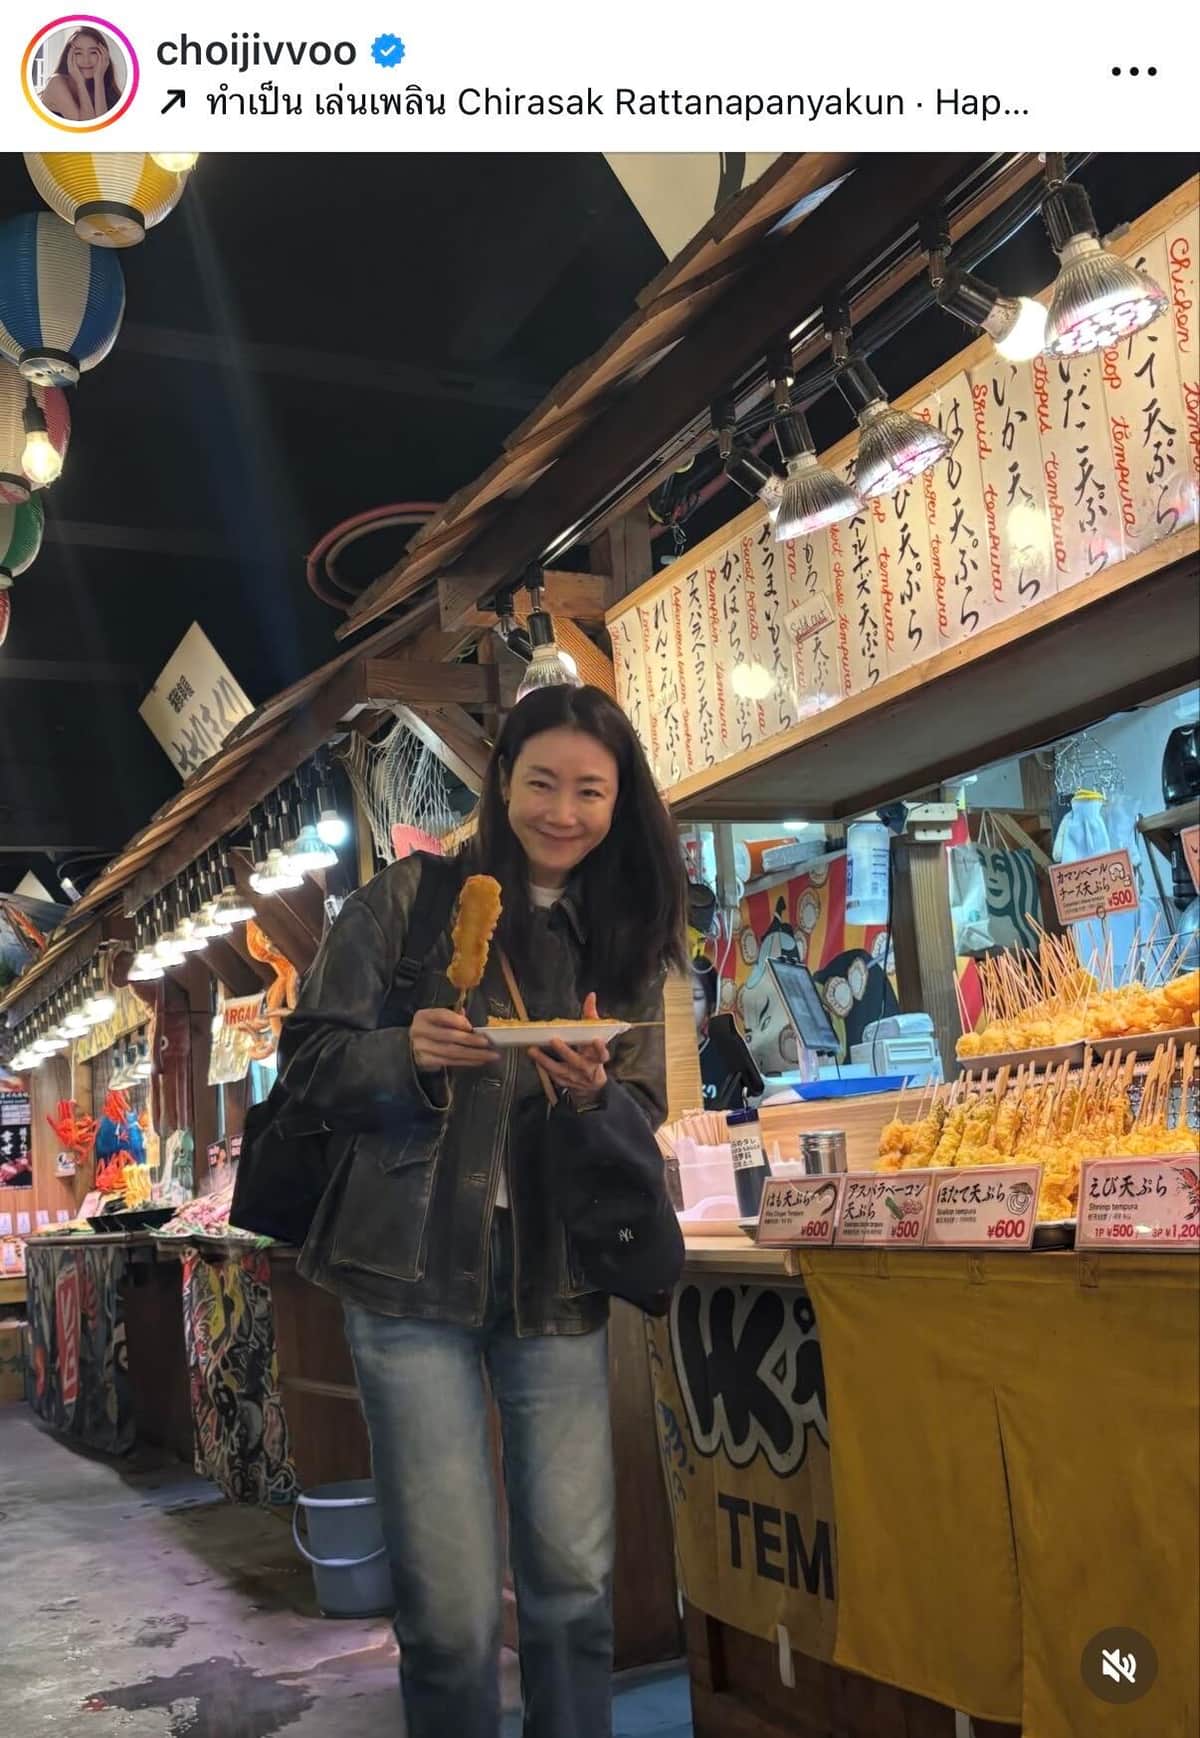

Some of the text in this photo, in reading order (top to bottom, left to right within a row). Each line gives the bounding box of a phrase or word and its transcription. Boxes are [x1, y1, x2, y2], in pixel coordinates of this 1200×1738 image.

[1033, 356, 1053, 434] ctopus
[1108, 889, 1132, 906] ¥500
[848, 1182, 927, 1199] アスパラベーコン
[936, 1183, 1006, 1204] ほたて天ぷら
[1089, 1174, 1168, 1198] えび天ぷら
[801, 1220, 829, 1237] ¥600
[891, 1221, 920, 1238] ¥500
[987, 1219, 1025, 1239] ¥600
[1106, 1223, 1134, 1238] ¥500
[718, 1491, 836, 1601] TEM
